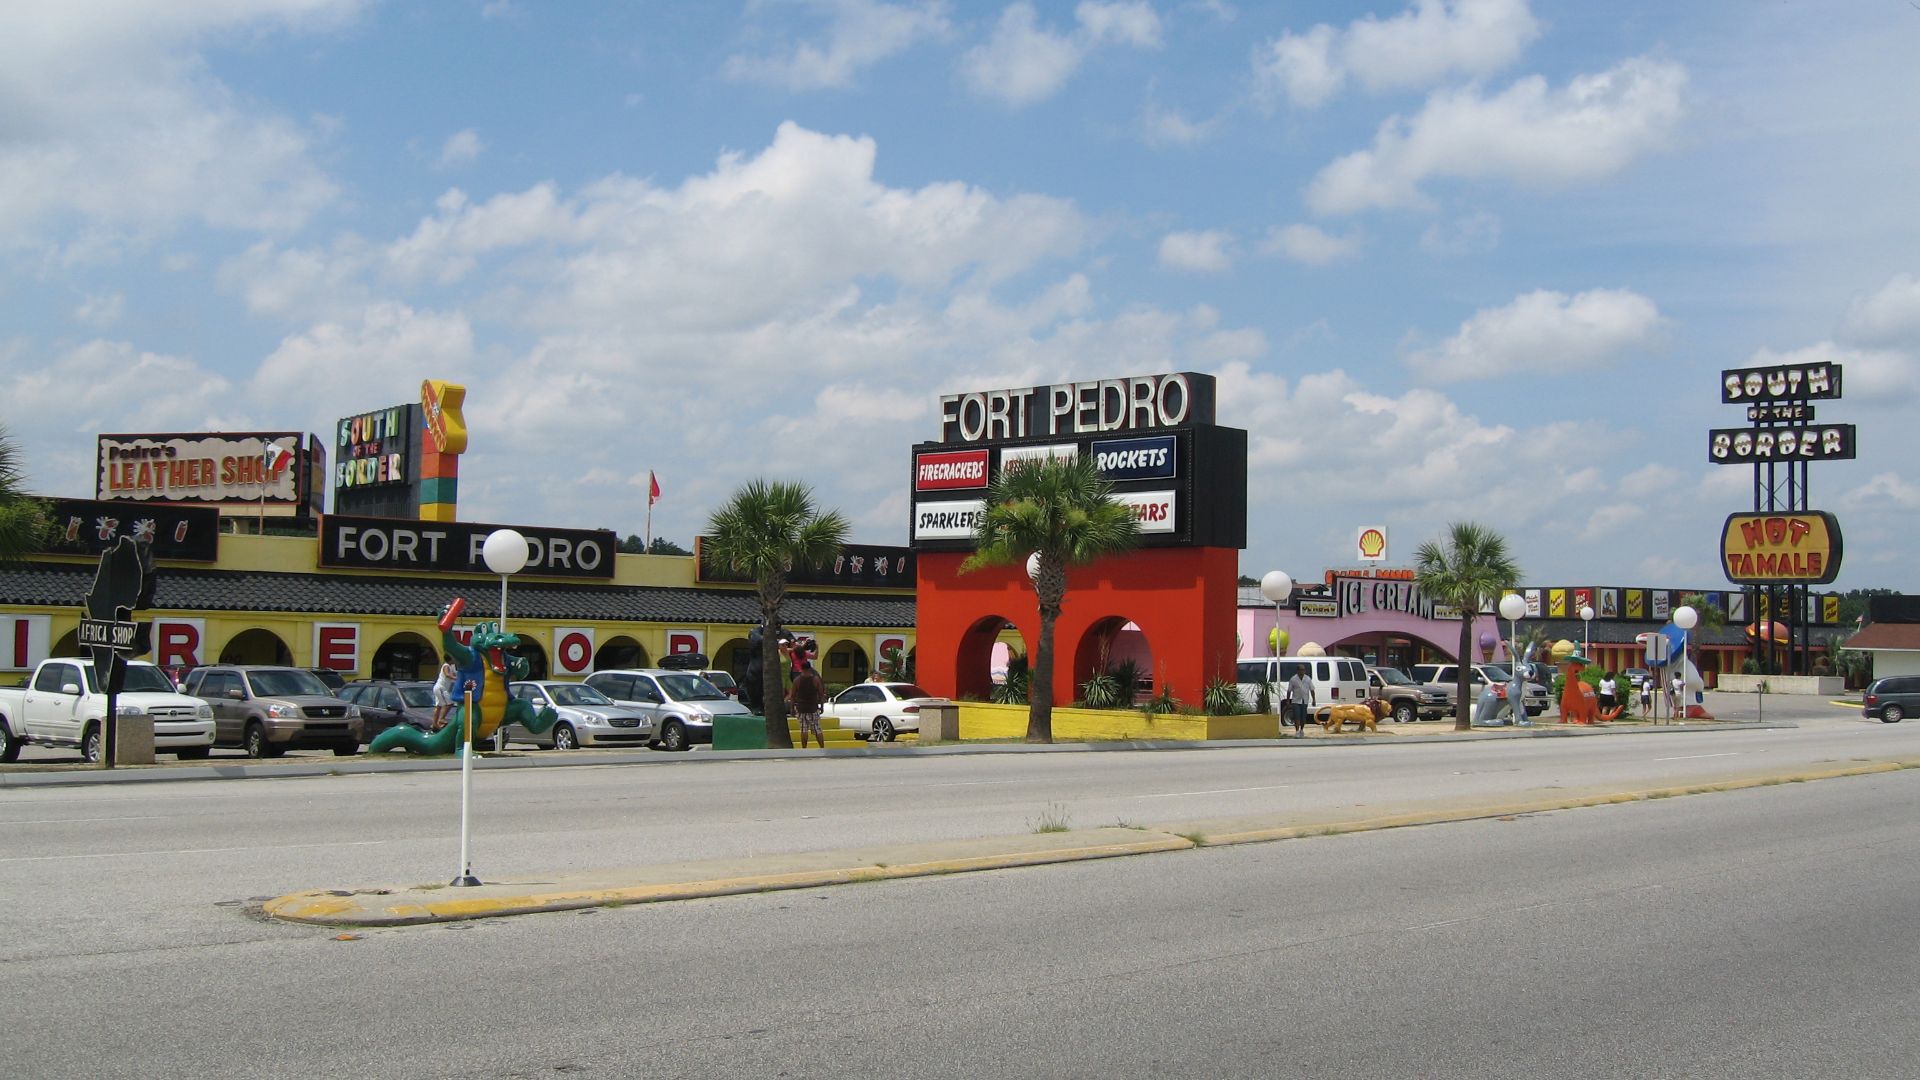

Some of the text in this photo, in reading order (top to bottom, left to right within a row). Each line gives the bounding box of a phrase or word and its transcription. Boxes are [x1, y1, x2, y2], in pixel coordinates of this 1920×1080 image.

[1725, 366, 1829, 399] SOUTH
[939, 372, 1191, 443] FORT PEDRO
[1748, 407, 1803, 419] OF THE
[340, 409, 400, 447] SOUTH
[1712, 428, 1841, 458] BORDER
[109, 445, 177, 460] Pedro's
[1096, 447, 1168, 472] ROCKETS
[110, 457, 217, 492] LEATHER
[336, 453, 402, 488] BORDER
[919, 460, 985, 482] FIRECRACKERS
[919, 511, 982, 530] SPARKLERS
[1741, 517, 1811, 551] HOT
[337, 526, 602, 571] FORT PDRO
[1727, 552, 1822, 577] TAMALE
[1340, 580, 1433, 621] ICE CREAM
[80, 622, 134, 646] AFRICA SHOP
